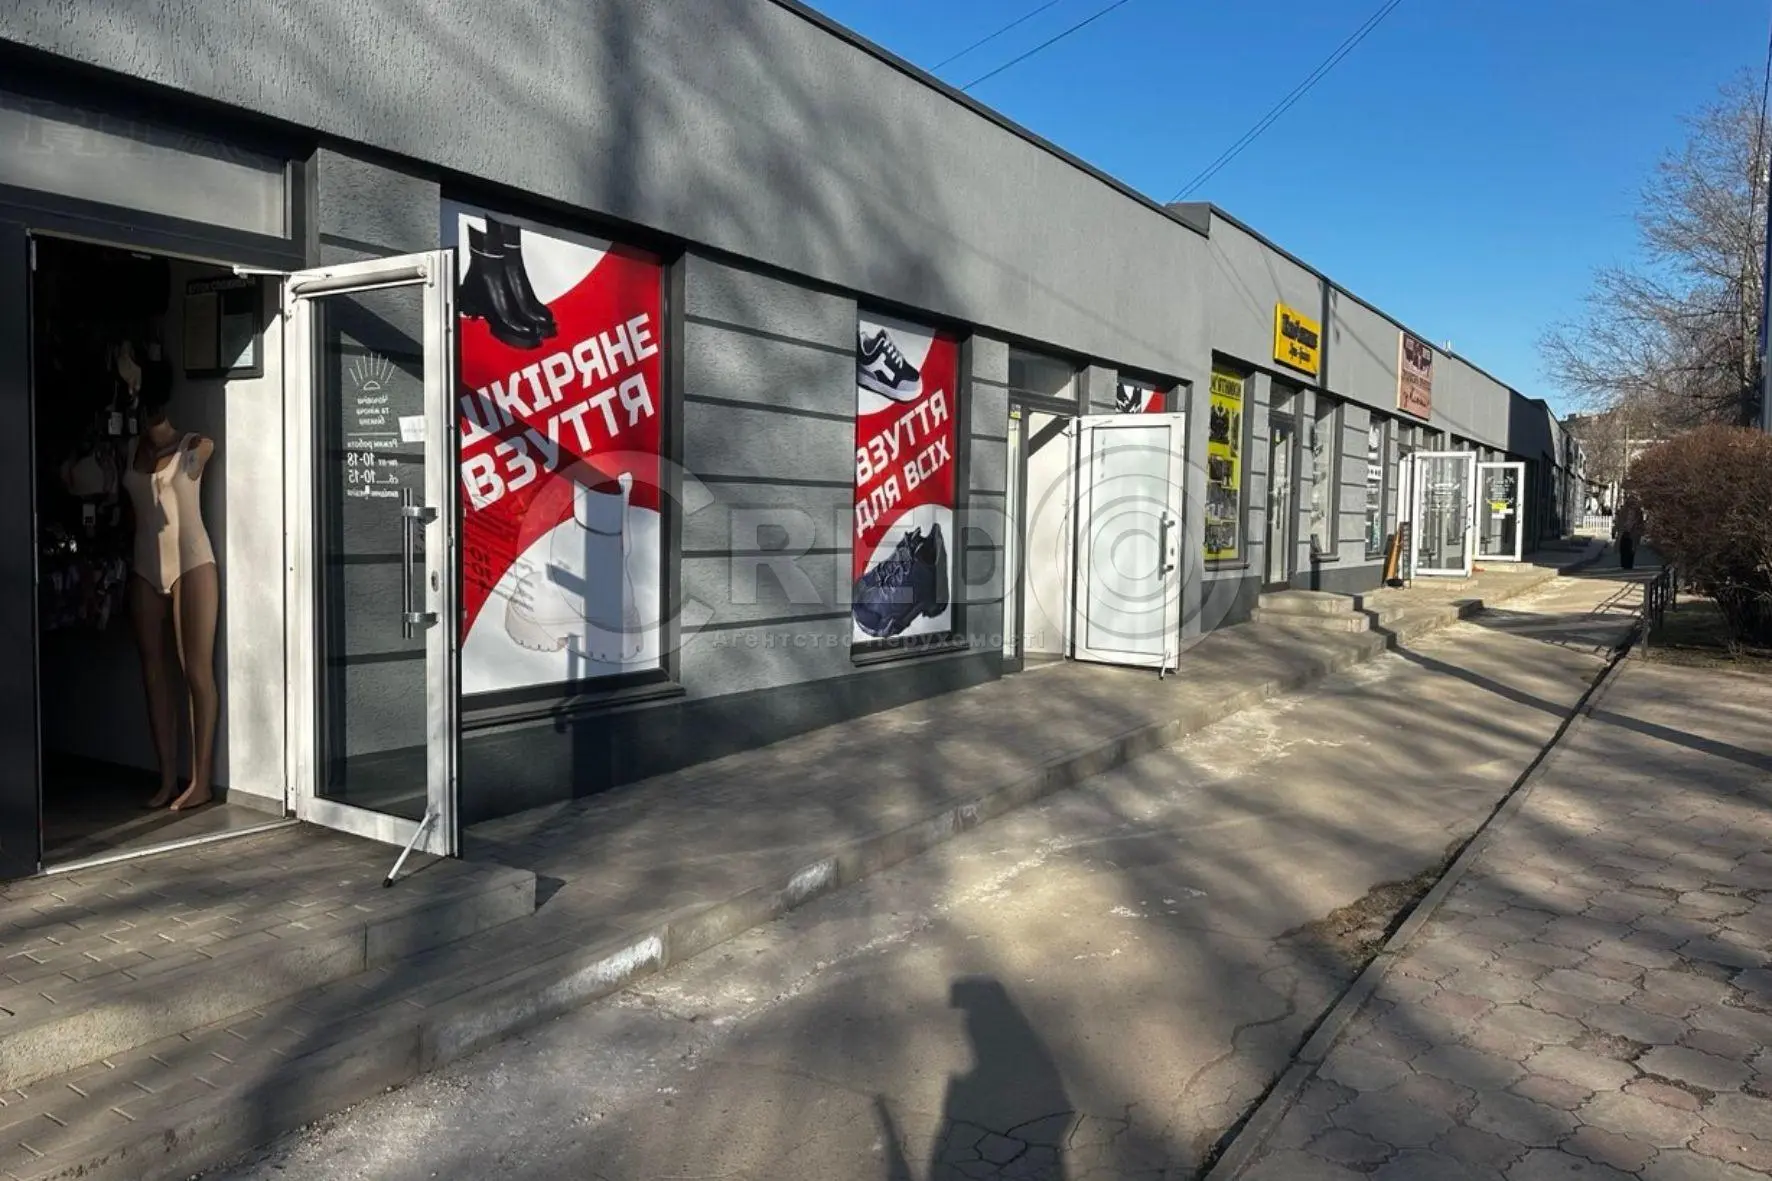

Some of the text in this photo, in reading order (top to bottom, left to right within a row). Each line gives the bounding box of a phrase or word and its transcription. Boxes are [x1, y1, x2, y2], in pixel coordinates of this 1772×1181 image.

[460, 313, 658, 449] ШКІРЯНЕ
[855, 390, 949, 487] ВЗУТТЯ
[460, 372, 655, 512] ВЗУТТЯ
[855, 435, 952, 539] ДЛЯ ВСІХ
